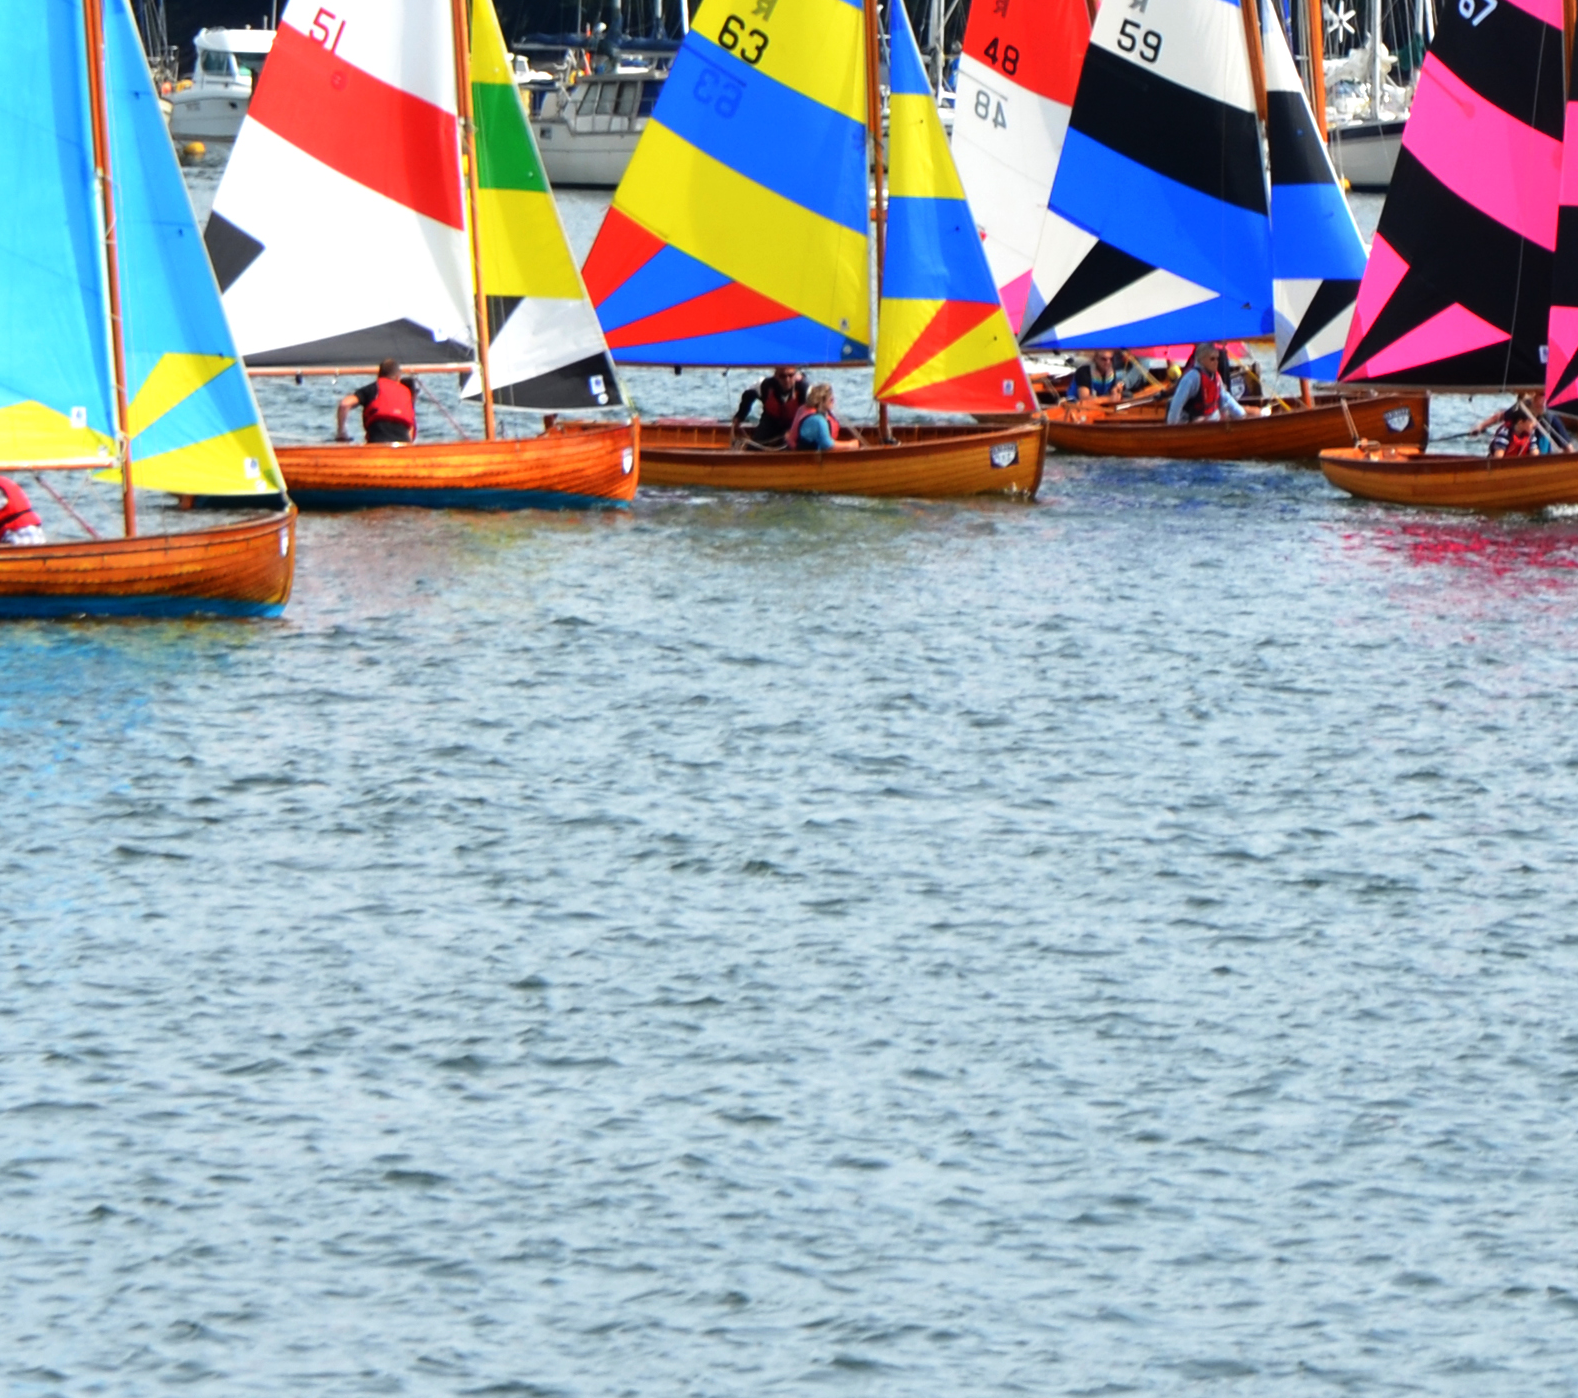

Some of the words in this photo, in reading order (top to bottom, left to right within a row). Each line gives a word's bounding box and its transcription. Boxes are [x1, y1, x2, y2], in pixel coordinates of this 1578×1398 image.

[309, 7, 347, 55] 51
[718, 14, 769, 65] 63
[1117, 17, 1163, 64] 59
[984, 36, 1020, 76] 48
